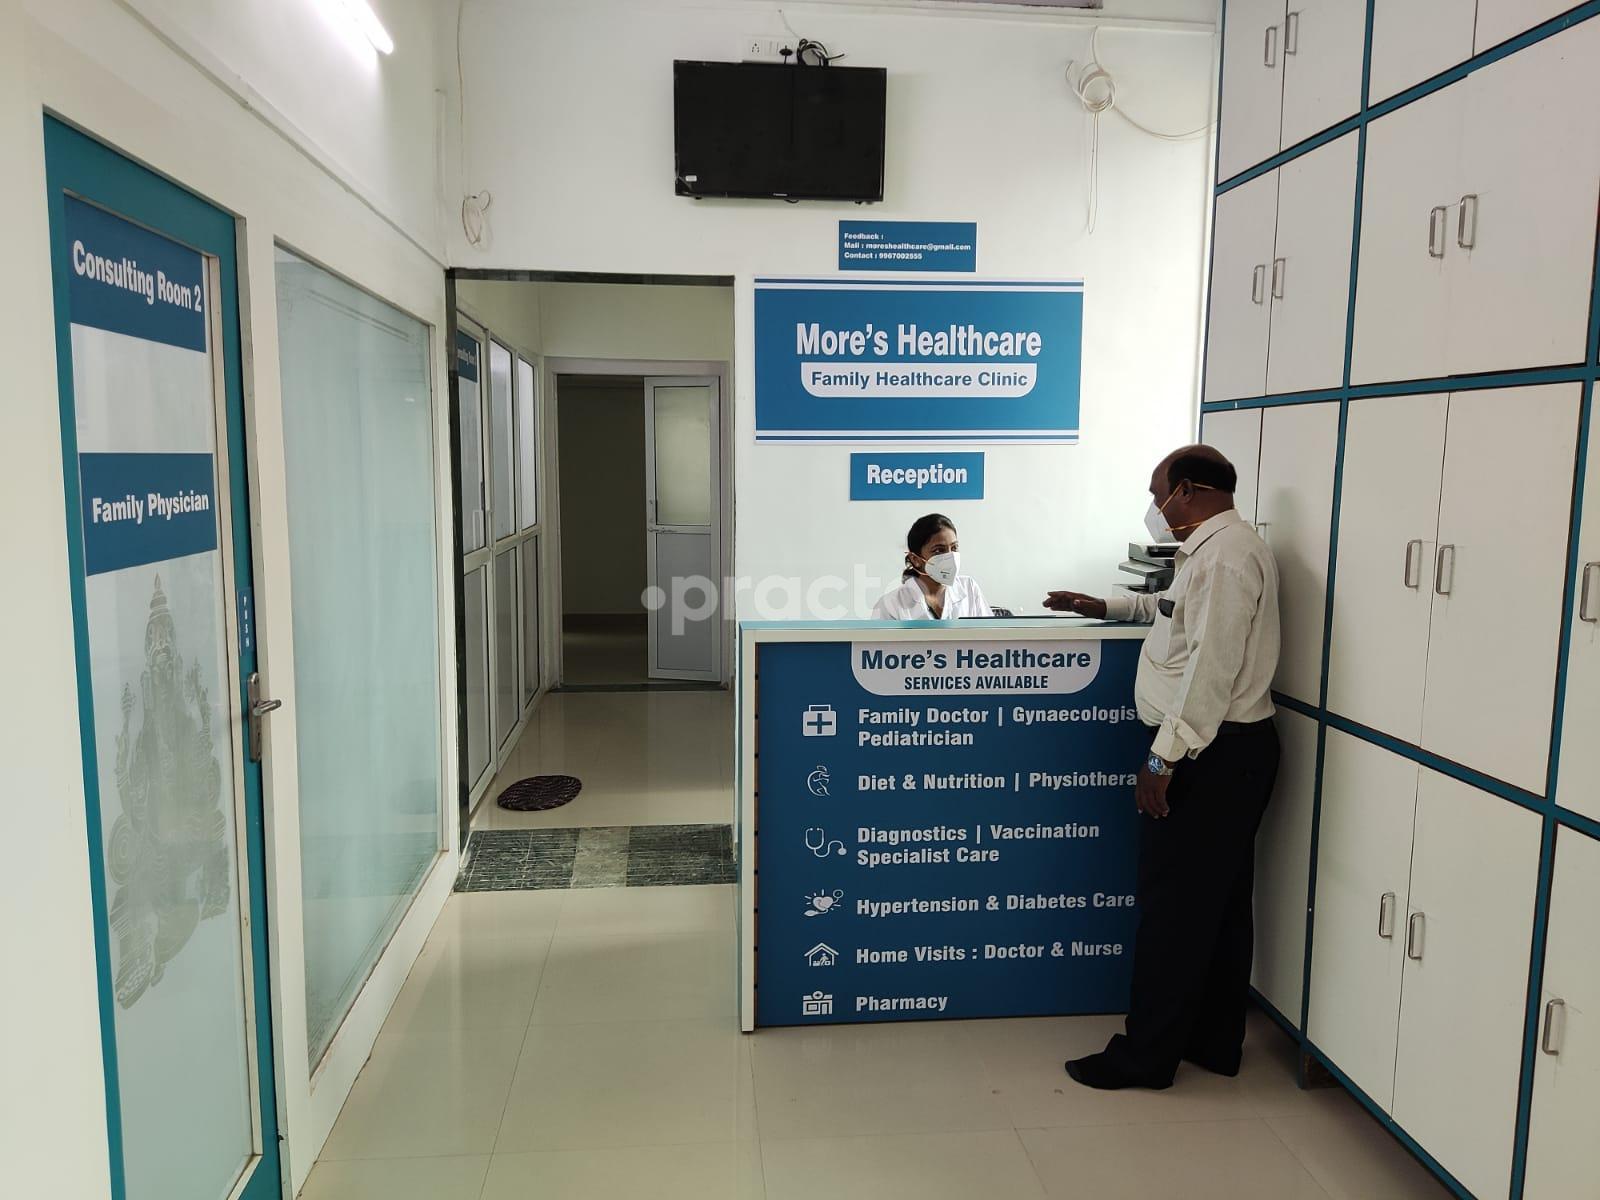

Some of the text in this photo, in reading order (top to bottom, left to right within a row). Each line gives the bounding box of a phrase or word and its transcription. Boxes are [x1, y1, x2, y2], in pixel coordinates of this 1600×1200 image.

[844, 232, 880, 240] Feedback
[73, 240, 202, 313] Consulting Room 2
[796, 323, 1042, 357] More's Healthcare
[811, 371, 1028, 389] Family Healthcare Clinic
[867, 463, 968, 488] Reception
[92, 490, 209, 525] Family Physician
[861, 649, 1091, 670] More's Healthcare
[904, 675, 1049, 690] SERVICES AVAILABLE
[858, 708, 920, 727] Family
[926, 707, 989, 723] Doctor
[858, 730, 974, 747] Pediatrician
[858, 774, 896, 791] Diet
[902, 774, 916, 790] &
[923, 773, 1005, 790] Nutrition
[1029, 771, 1138, 791] Physiothera
[857, 825, 967, 845] Diagnostics
[990, 822, 1100, 840] Vaccination
[857, 847, 1000, 868] Specialist Care
[856, 892, 1136, 917] Hypertension & Diabetes Care
[856, 948, 908, 964] Home
[914, 945, 966, 962] Visits
[984, 943, 1045, 960] Doctor
[1050, 941, 1065, 957] &
[1071, 940, 1123, 957] Nurse
[855, 996, 948, 1012] Pharmacy
